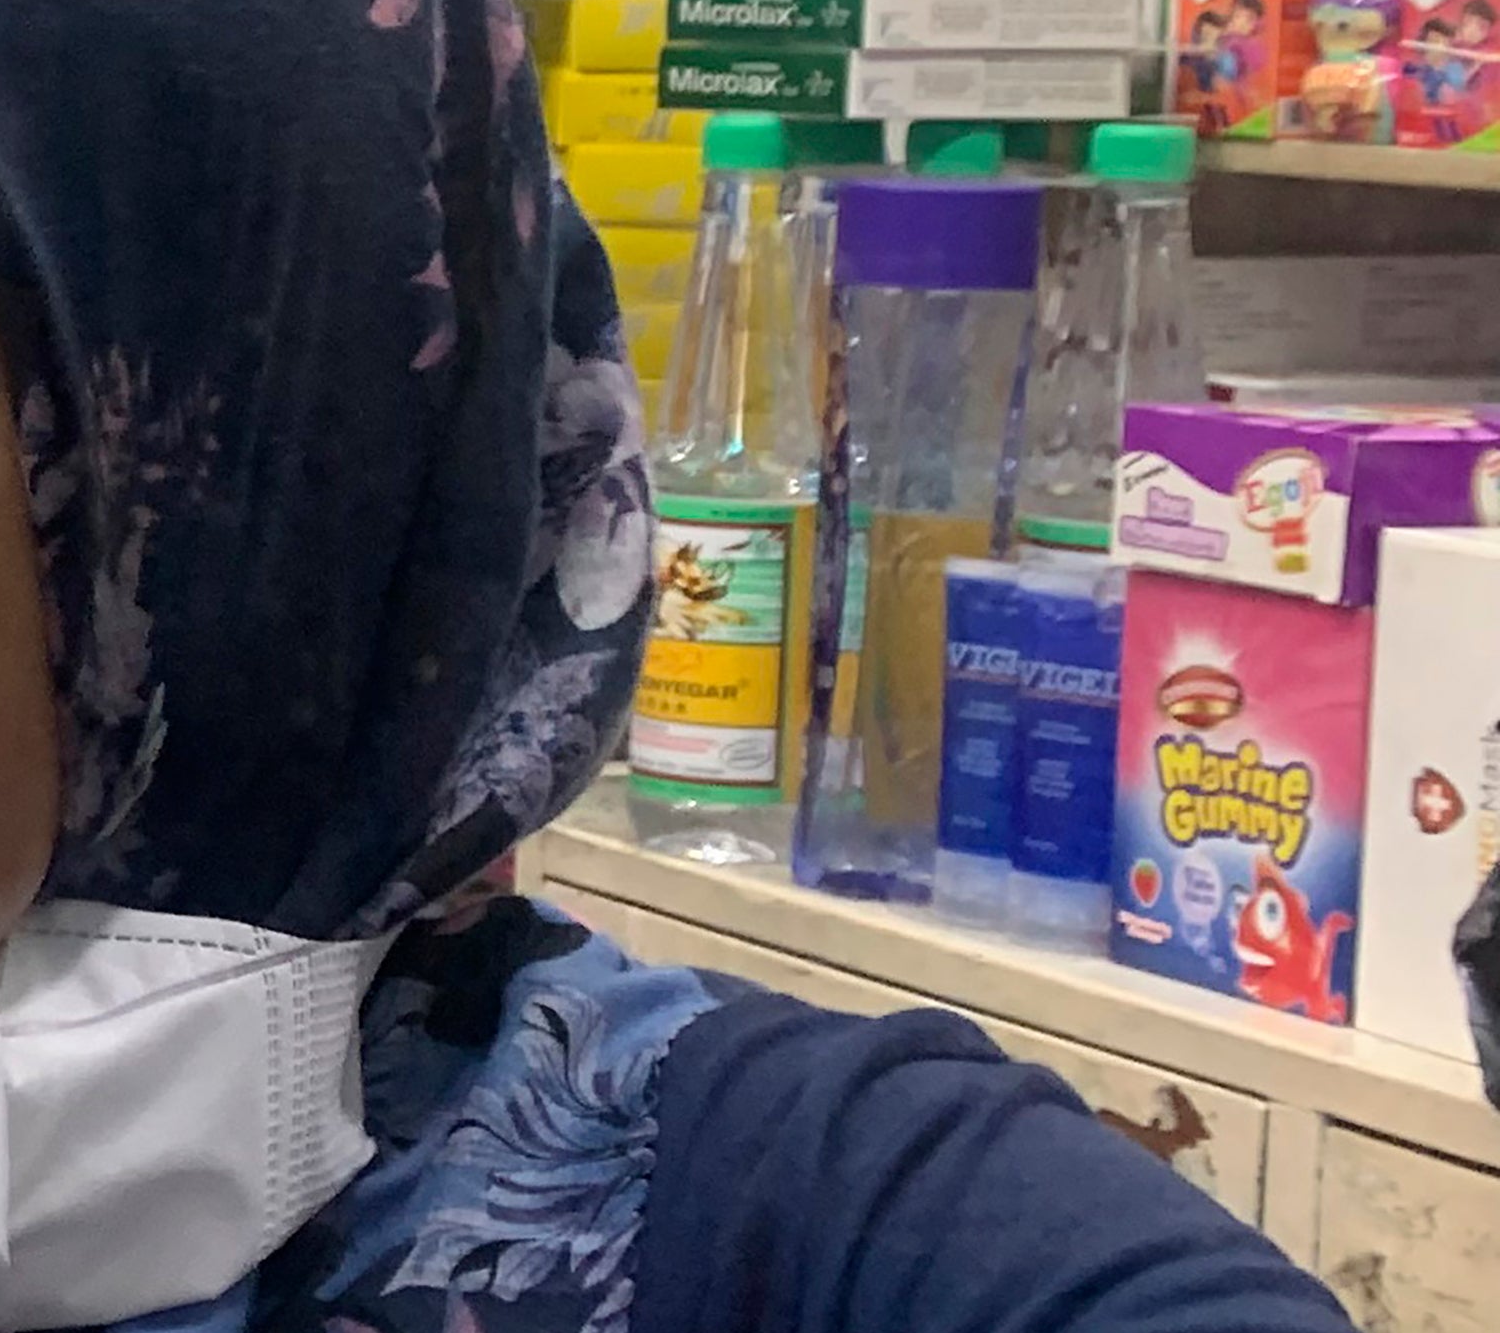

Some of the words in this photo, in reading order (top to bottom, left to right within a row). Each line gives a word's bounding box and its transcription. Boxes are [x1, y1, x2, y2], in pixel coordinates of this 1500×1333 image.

[668, 67, 780, 98] Microlax
[1156, 734, 1311, 810] Marine
[1160, 789, 1310, 868] Gummy
